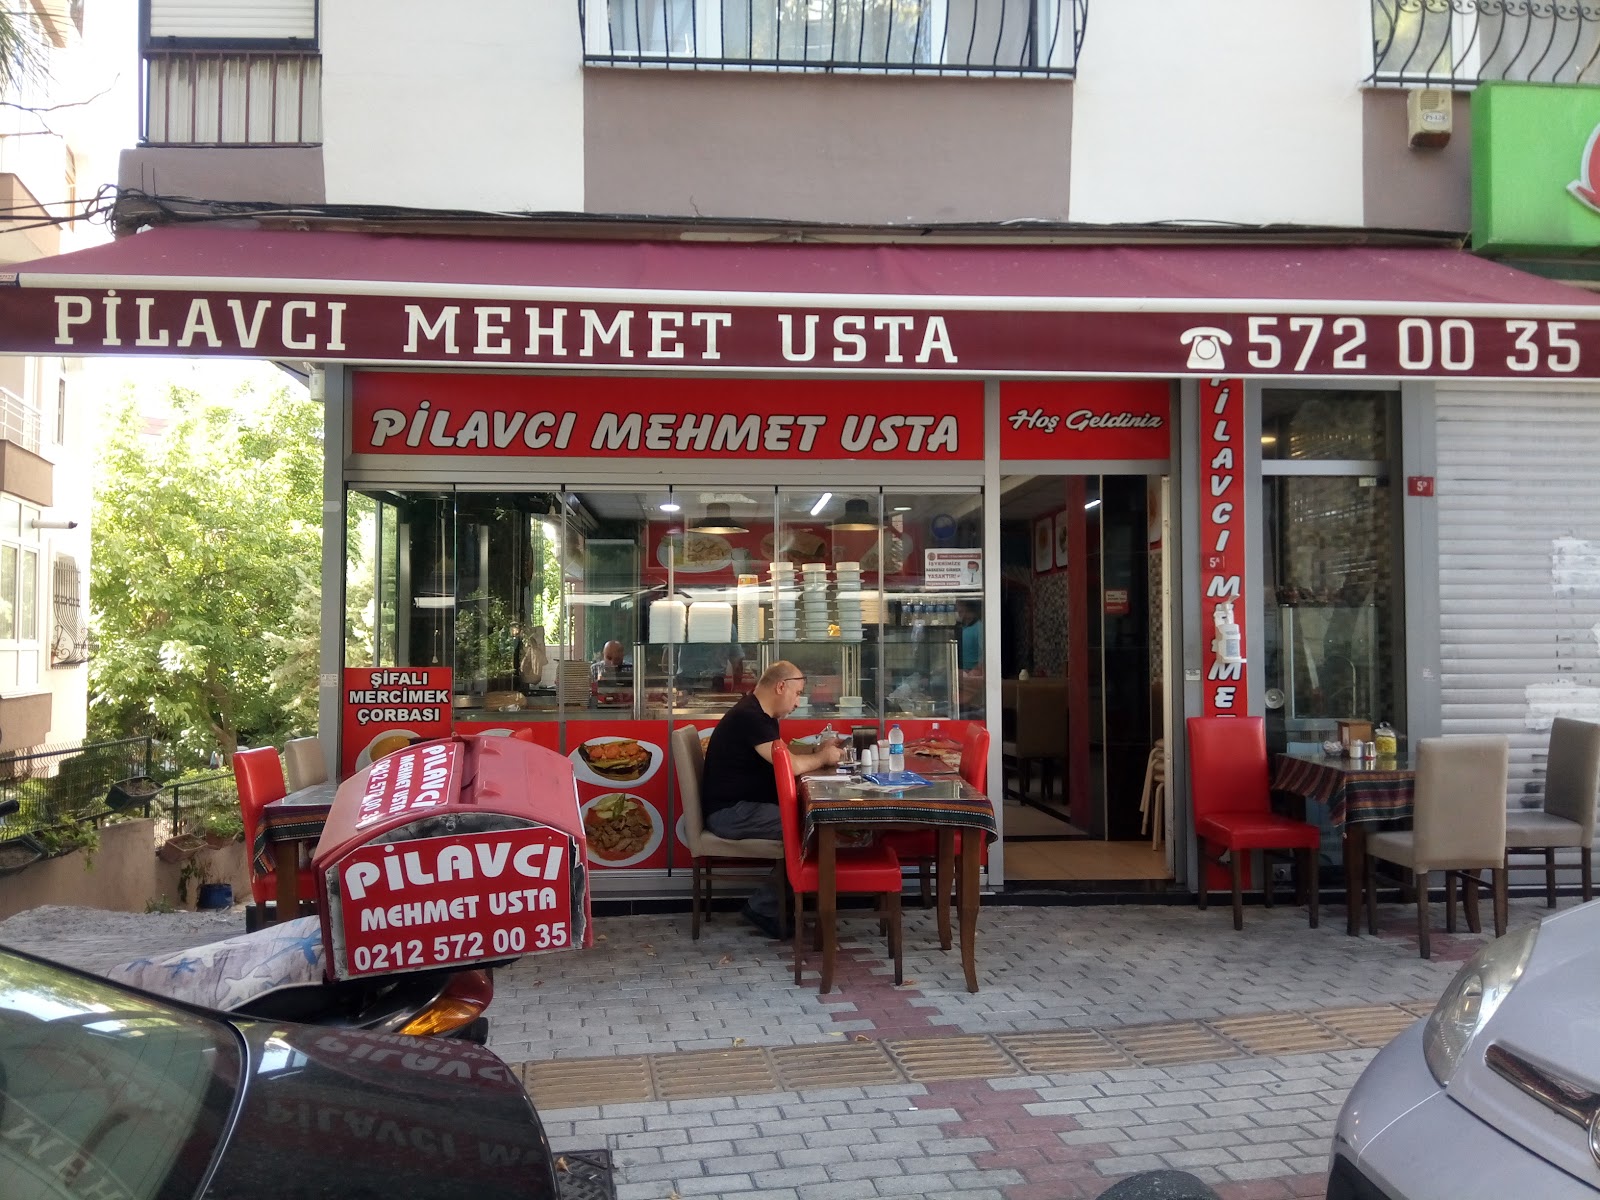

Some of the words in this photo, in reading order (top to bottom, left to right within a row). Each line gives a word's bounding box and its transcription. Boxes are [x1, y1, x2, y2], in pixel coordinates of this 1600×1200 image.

[54, 289, 347, 351] PİLAVCI
[402, 304, 732, 360] MEHMET
[777, 313, 959, 364] USTA
[1246, 316, 1368, 371] 572
[1398, 318, 1475, 372] 00
[1506, 320, 1582, 374] 35
[370, 400, 576, 450] PİLAVCI
[590, 411, 826, 452] MEHMET
[839, 415, 959, 454] USTA
[1008, 408, 1060, 433] Hoş
[1065, 409, 1164, 431] Geldiniz
[349, 688, 449, 704] MERCİMEK
[370, 669, 428, 689] ŞİFALI
[357, 708, 440, 726] ÇORBASI
[395, 754, 415, 790] MEHMET
[410, 744, 453, 808] PİLAVCI
[389, 789, 410, 813] USTA
[344, 842, 564, 901] PİLAVCI
[360, 895, 480, 932] MEHMET
[489, 887, 557, 915] USTA
[353, 939, 424, 971] 0212
[433, 931, 484, 962] 572
[493, 926, 525, 953] 00
[535, 921, 567, 949] 35
